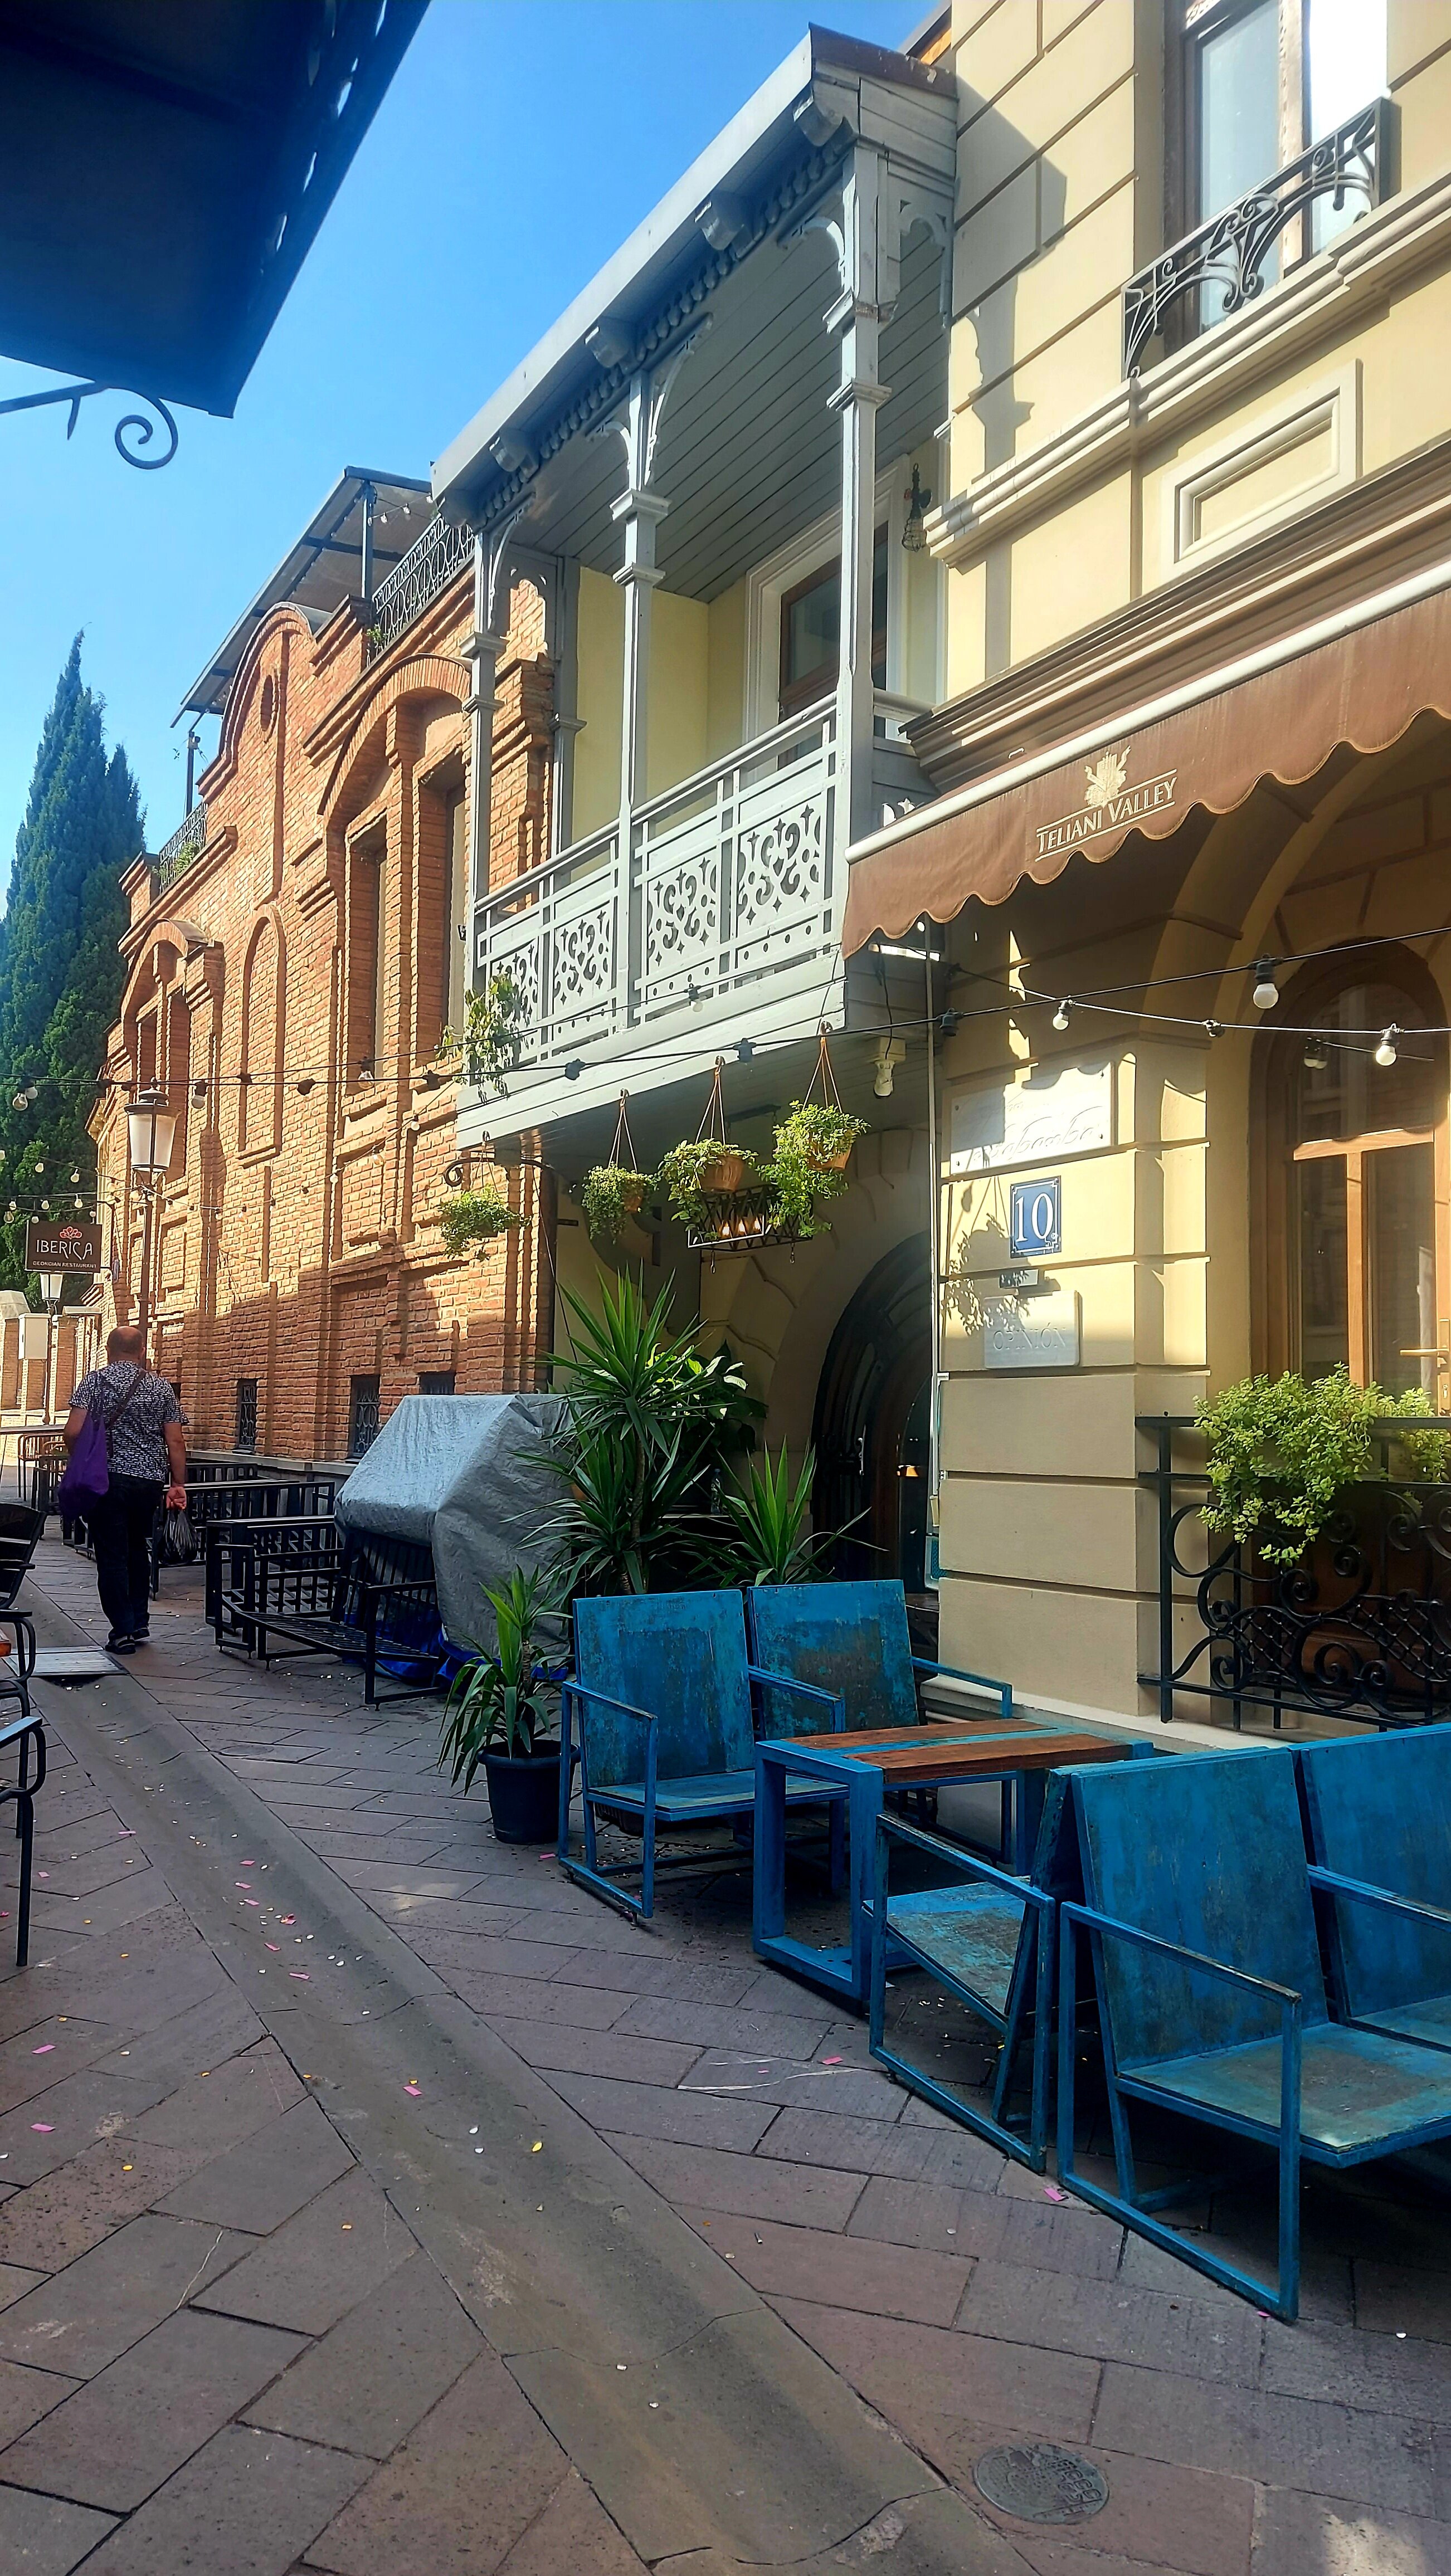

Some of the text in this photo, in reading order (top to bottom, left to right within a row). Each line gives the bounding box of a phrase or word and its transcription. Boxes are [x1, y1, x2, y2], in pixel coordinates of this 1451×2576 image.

[1036, 777, 1177, 853] TELIANI VALLEY
[1015, 1192, 1054, 1242] 10
[36, 1240, 92, 1260] IBERICA
